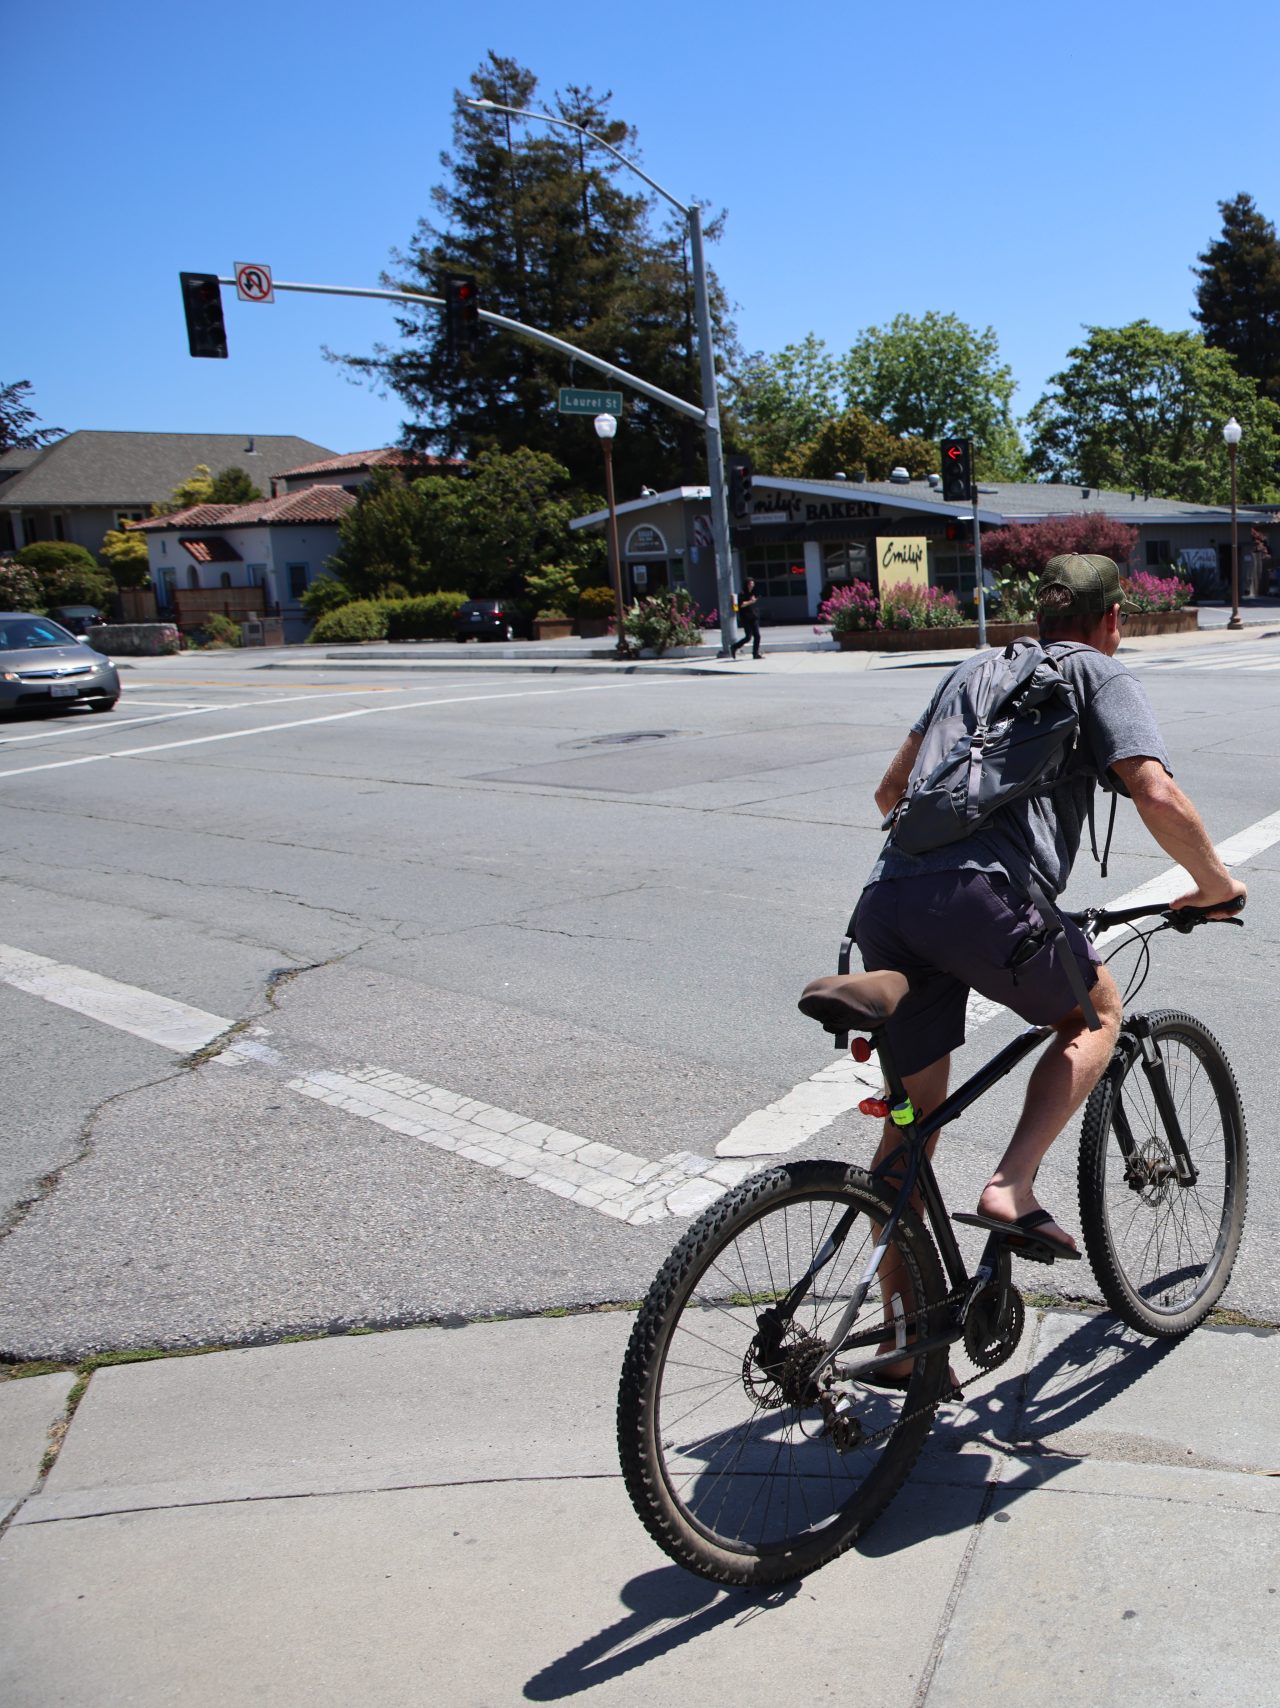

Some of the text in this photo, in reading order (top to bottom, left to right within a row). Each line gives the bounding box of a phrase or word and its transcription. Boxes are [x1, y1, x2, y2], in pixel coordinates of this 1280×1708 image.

[565, 396, 617, 409] Laurel St
[805, 501, 881, 521] BAKERY
[882, 541, 923, 573] Emily's
